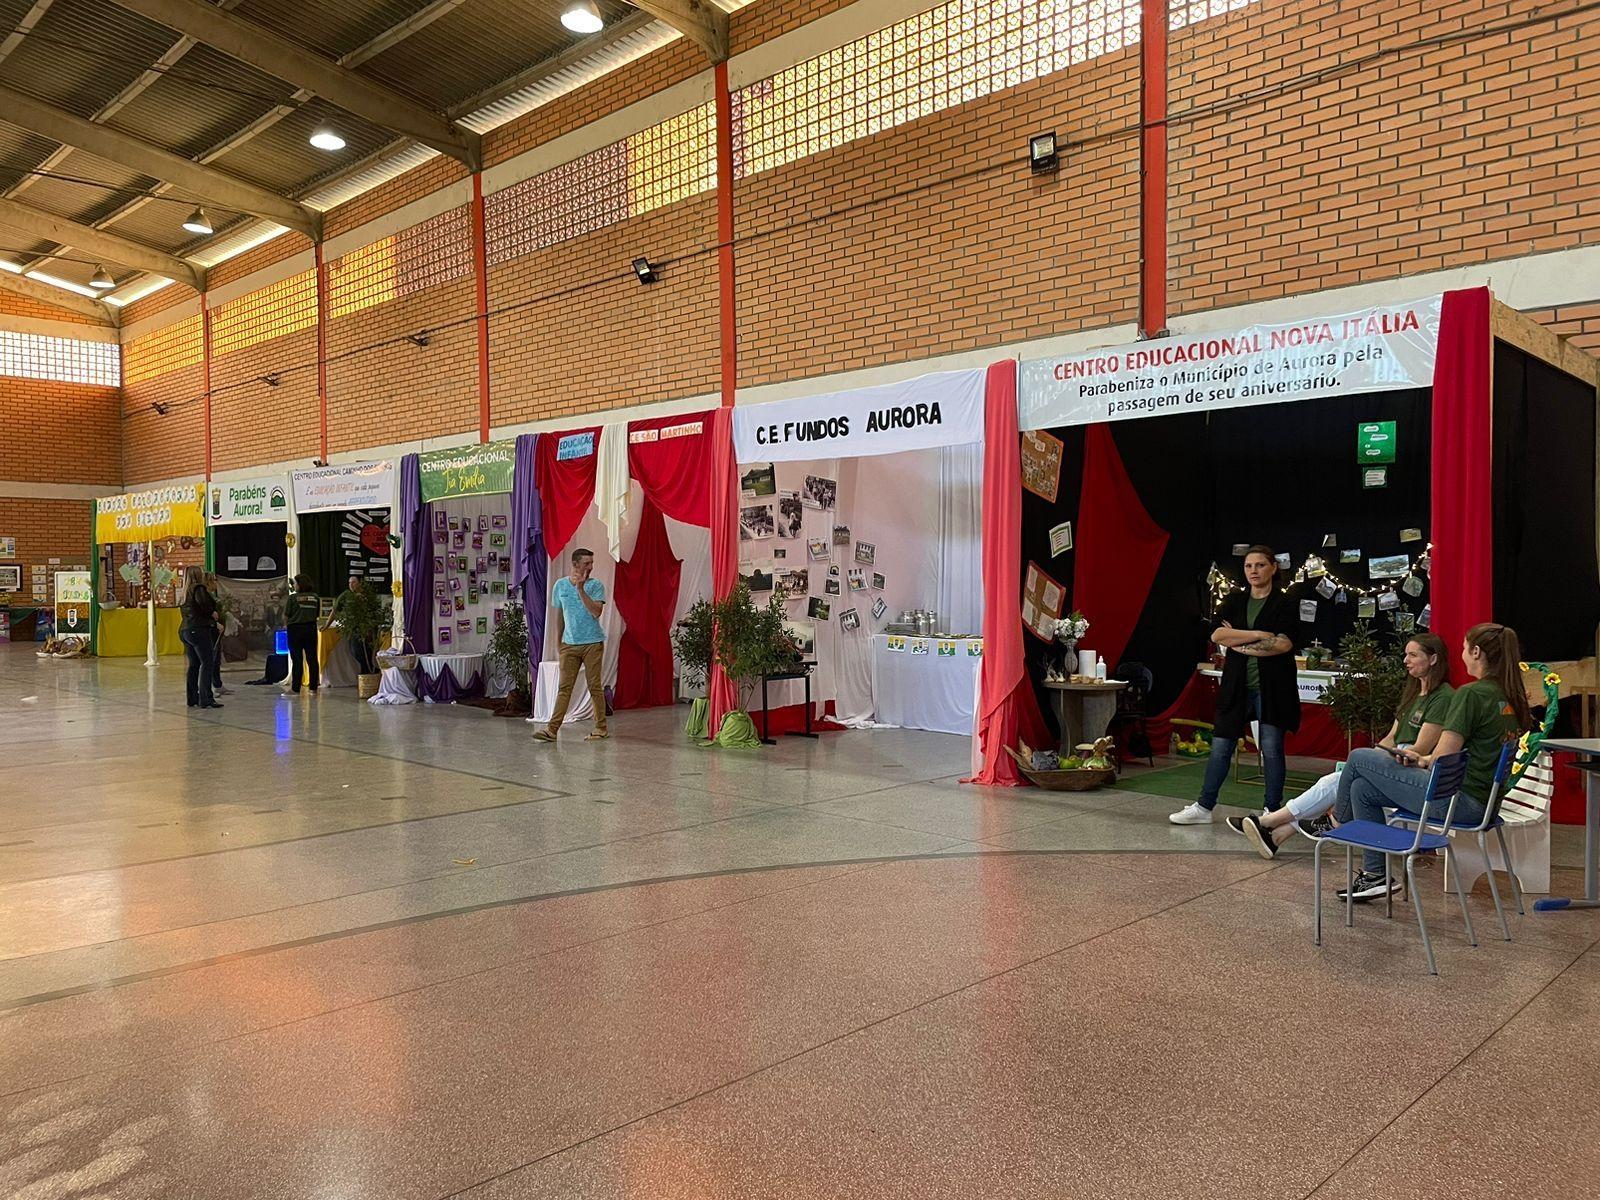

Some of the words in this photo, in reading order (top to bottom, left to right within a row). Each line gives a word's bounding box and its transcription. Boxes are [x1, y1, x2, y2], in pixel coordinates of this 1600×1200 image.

[1054, 356, 1119, 380] CENTRO
[1126, 334, 1262, 371] EDUCACIONAL
[1270, 323, 1334, 350] NOVA
[1342, 310, 1420, 340] ITÁLIA
[1079, 376, 1155, 398] Parabeniza
[1160, 376, 1168, 386] o
[1173, 363, 1248, 386] Município
[1254, 359, 1273, 375] de
[1279, 352, 1337, 372] Aurora
[1343, 344, 1383, 368] pela
[1108, 395, 1180, 416] passagem
[1185, 389, 1204, 404] de
[1208, 387, 1236, 401] seu
[1241, 373, 1341, 396] aniversário.
[661, 424, 702, 439] MARTINHO
[784, 416, 849, 441] FUNDOS
[865, 402, 942, 433] AURORA
[421, 459, 451, 473] CENTRO
[452, 450, 511, 468] EDUCACIONAL
[229, 485, 266, 501] Parabéns
[233, 501, 263, 516] Aurora!
